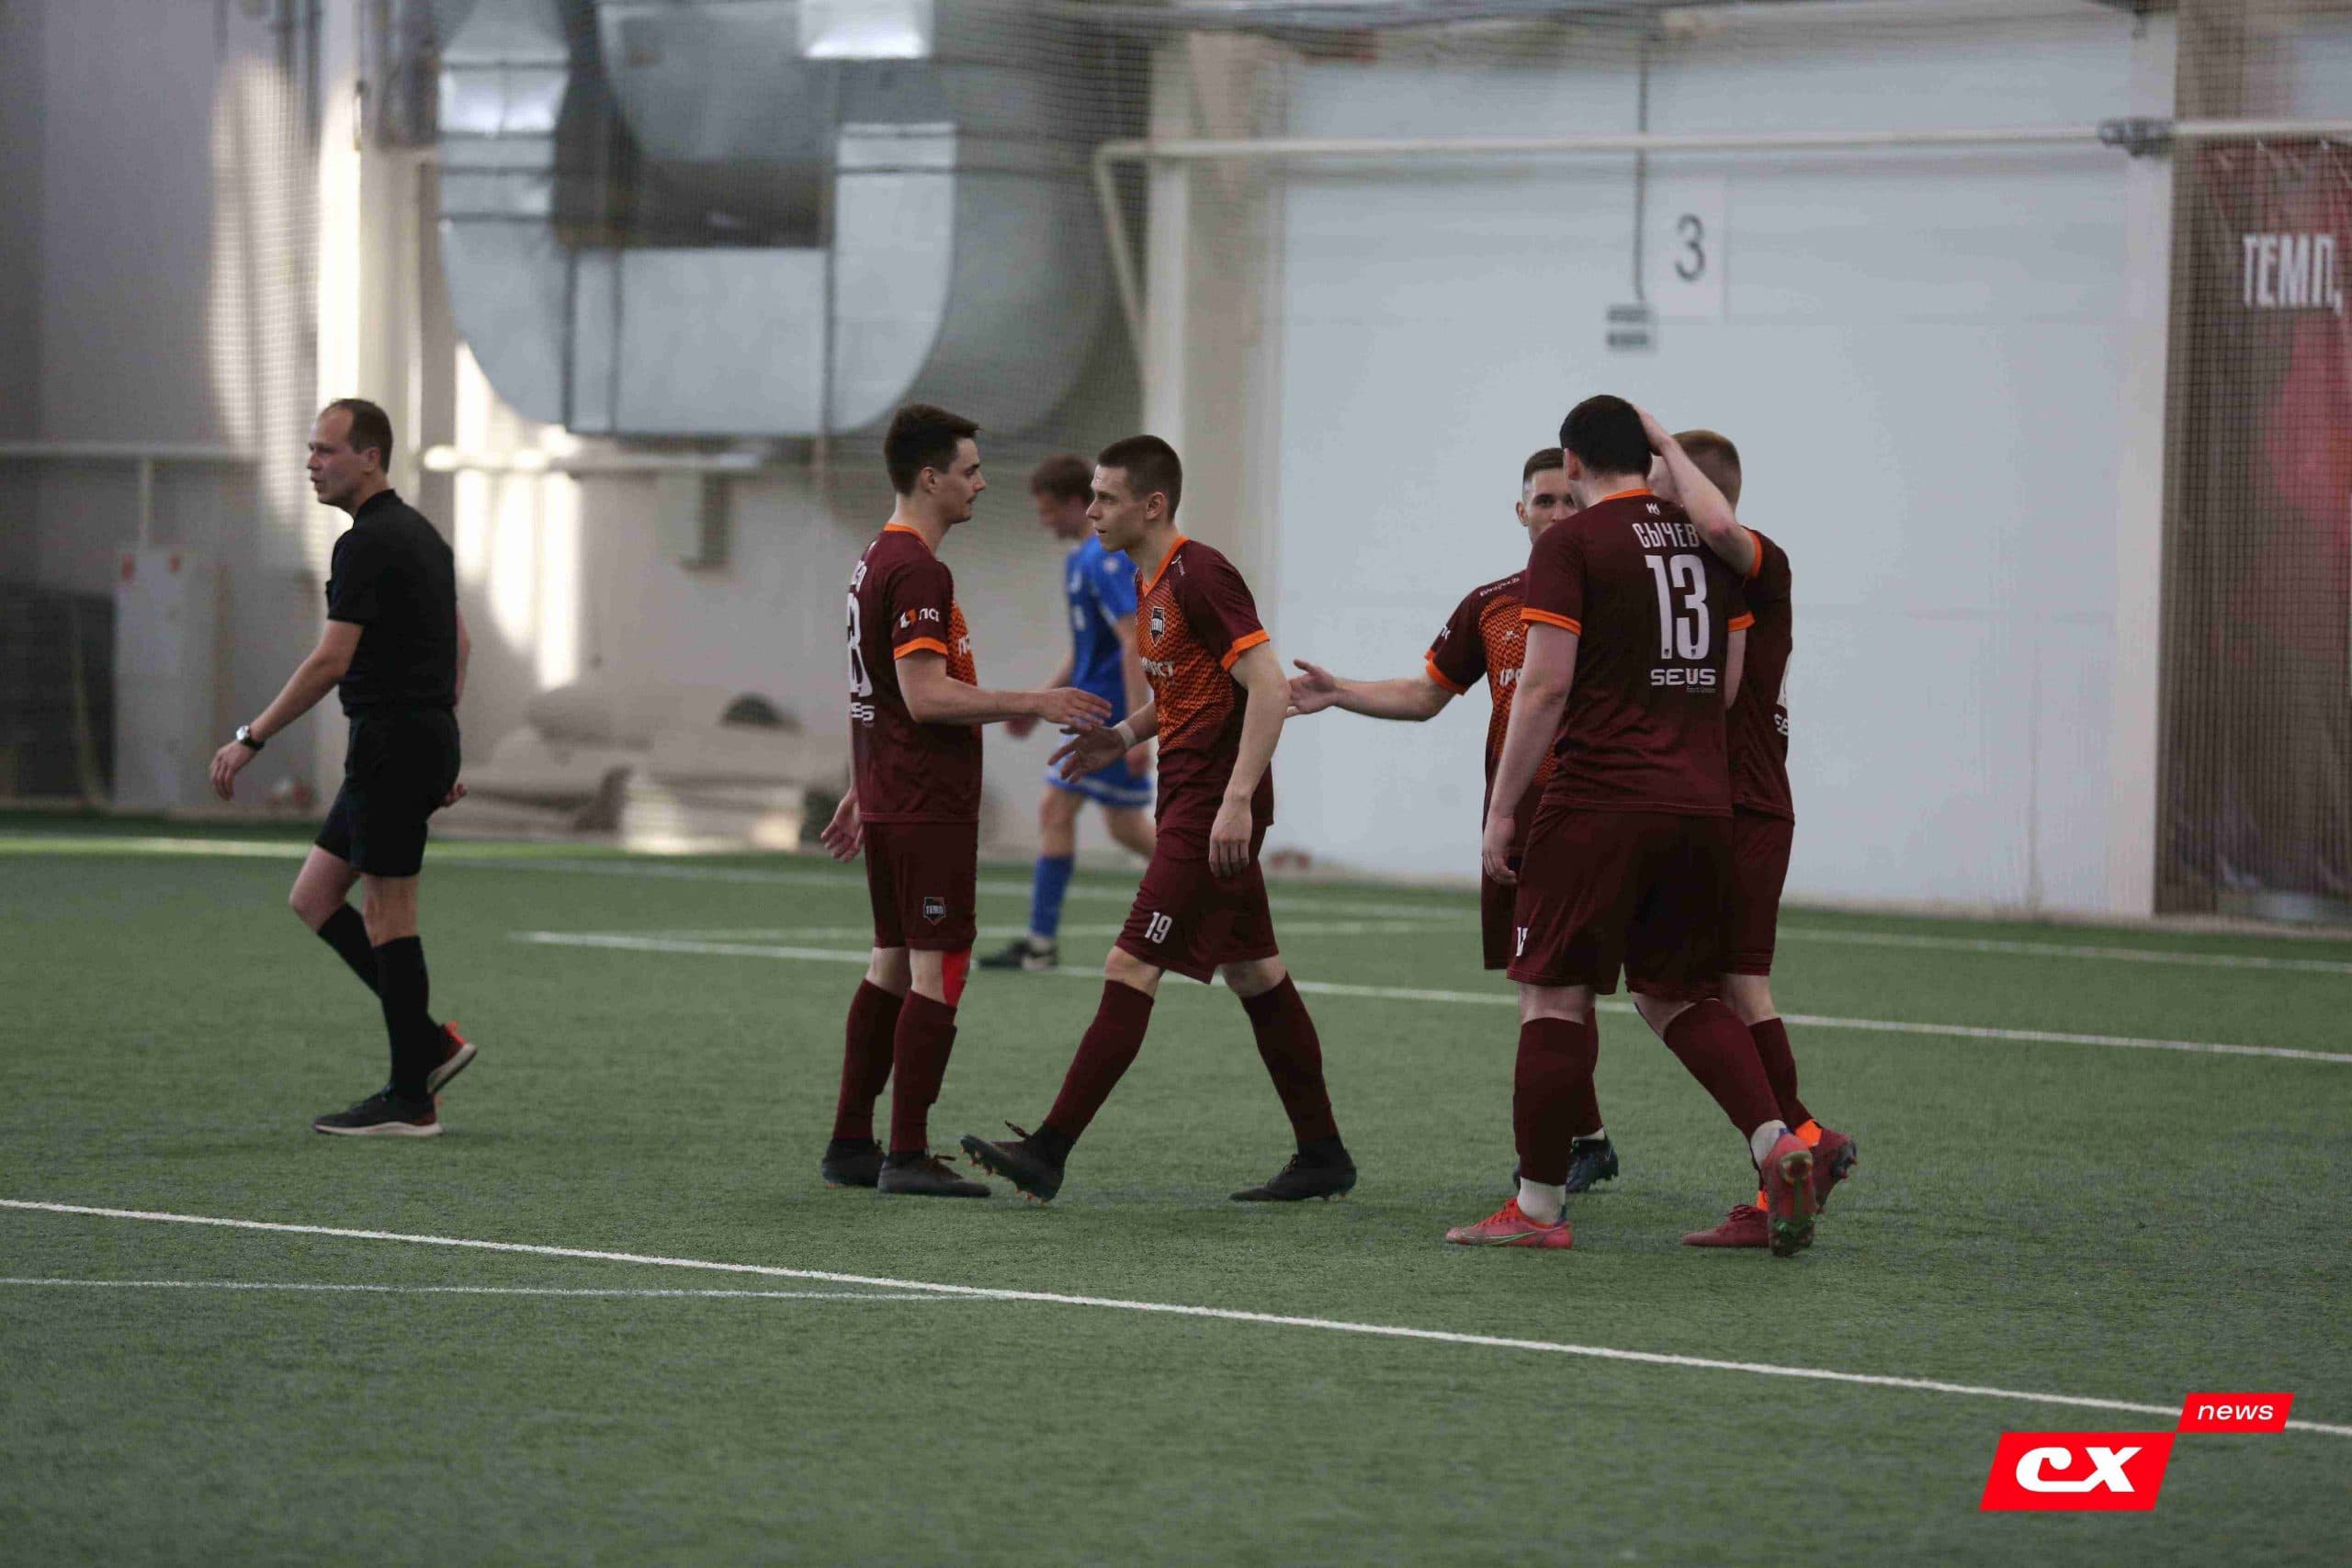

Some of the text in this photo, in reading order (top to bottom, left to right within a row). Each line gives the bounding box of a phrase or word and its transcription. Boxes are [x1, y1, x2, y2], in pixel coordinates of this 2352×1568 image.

[1674, 212, 1706, 283] 3
[1631, 522, 1701, 548] СЫЧЕВ
[1645, 554, 1710, 660] 13
[1650, 668, 1716, 686] SEUS
[1144, 911, 1173, 944] 19
